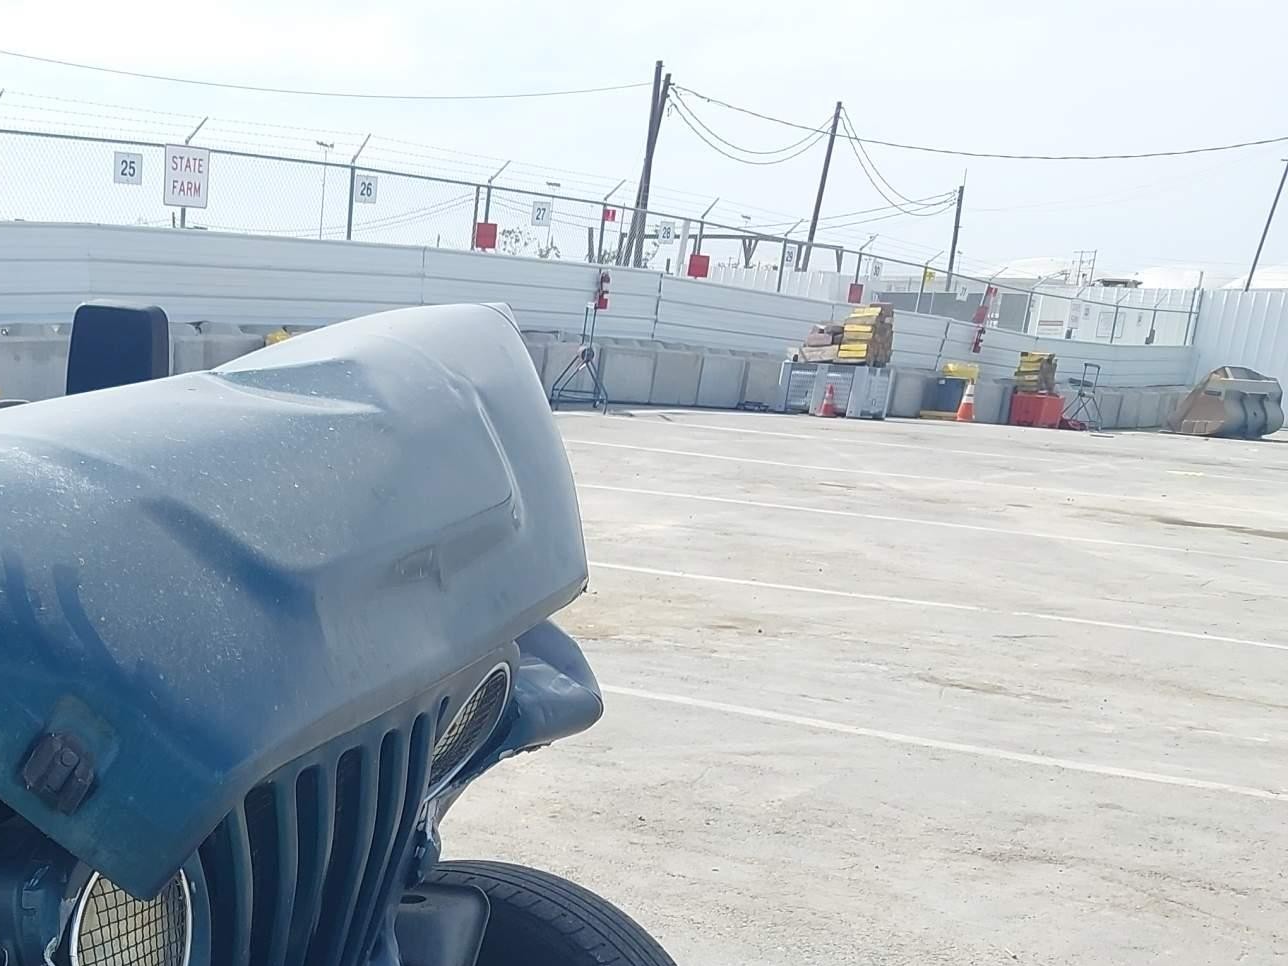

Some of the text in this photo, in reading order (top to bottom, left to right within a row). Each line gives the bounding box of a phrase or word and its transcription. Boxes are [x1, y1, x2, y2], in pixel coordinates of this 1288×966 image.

[120, 159, 137, 177] 25
[171, 155, 205, 175] STATE
[171, 180, 202, 198] FARM
[360, 182, 373, 197] 26
[535, 207, 547, 221] 27
[661, 226, 672, 240] 28
